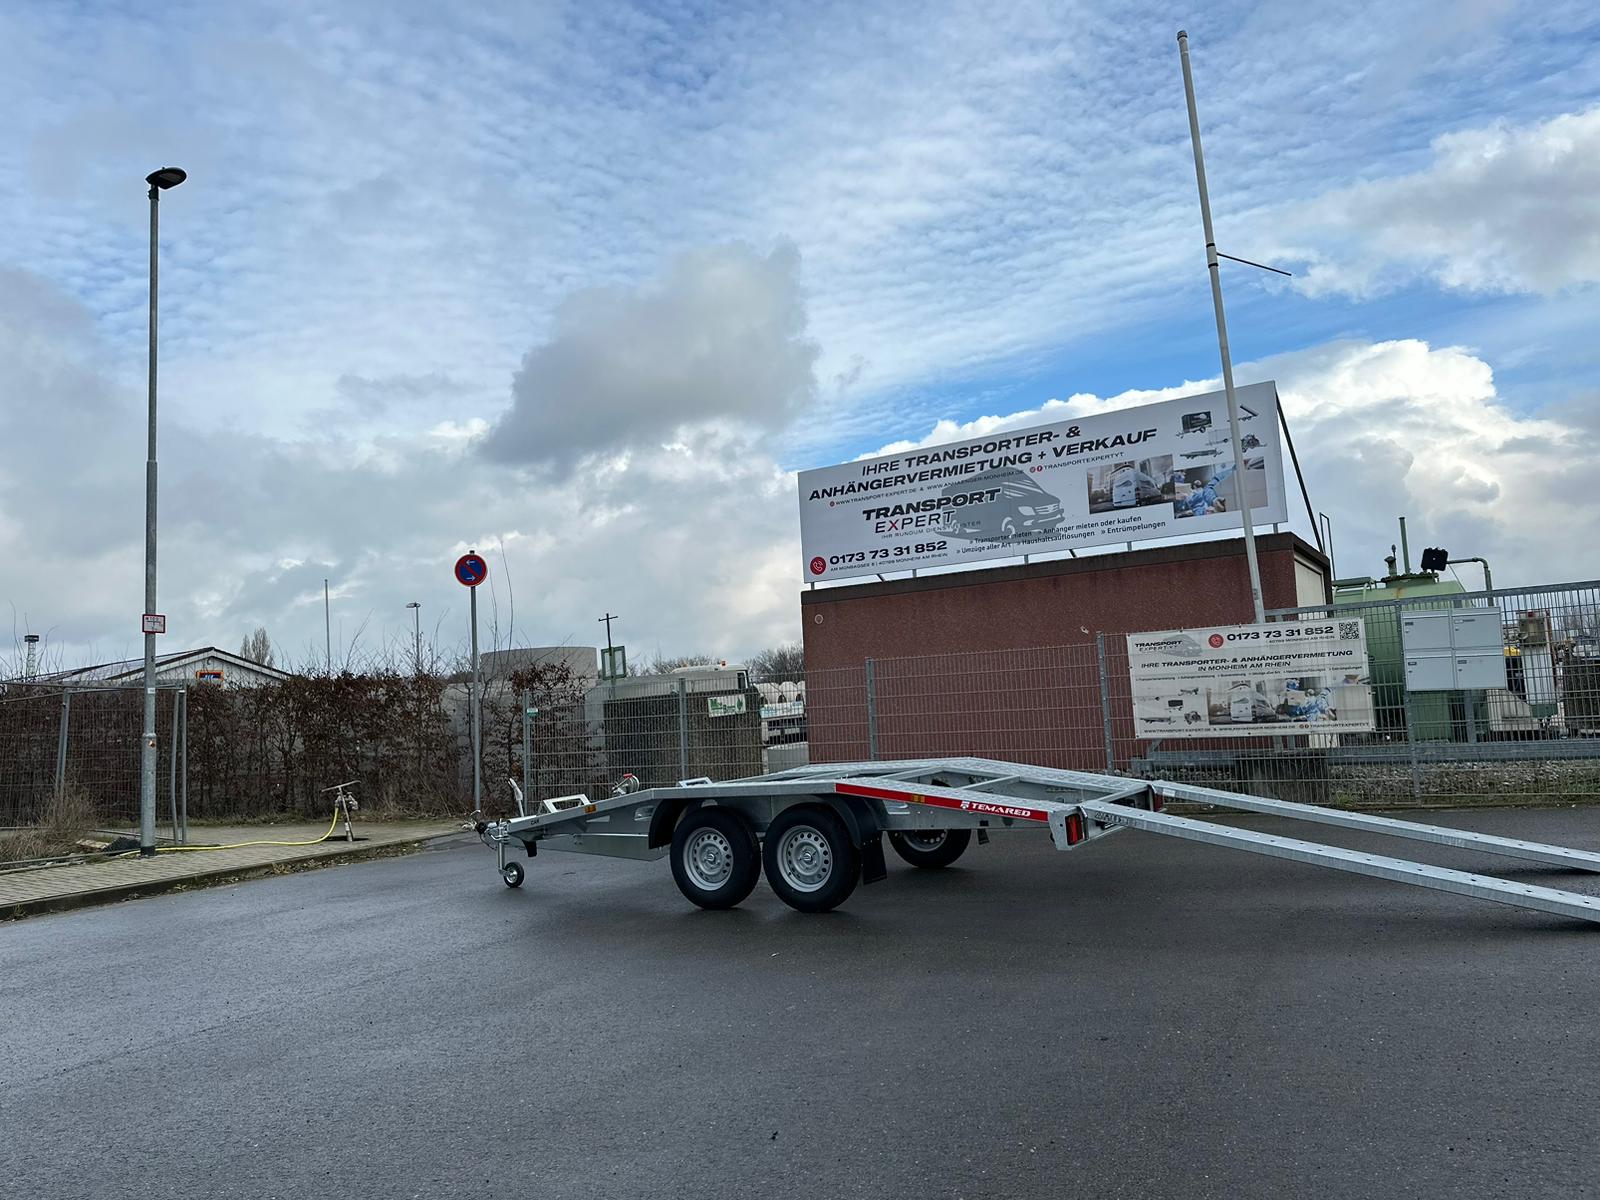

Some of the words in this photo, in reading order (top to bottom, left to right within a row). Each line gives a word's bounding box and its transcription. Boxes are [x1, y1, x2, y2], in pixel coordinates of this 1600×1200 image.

[862, 459, 900, 476] IHRE
[904, 430, 1060, 468] TRANSPORTER-
[1065, 425, 1081, 439] &
[1044, 452, 1125, 470] TRANSPORTEXPERTYT
[808, 452, 1033, 501] ANHÄNGERVERMIETUNG
[1038, 450, 1046, 460] +
[1052, 428, 1158, 458] VERKAUF
[862, 487, 1001, 521] TRANSPORT
[874, 510, 956, 534] EXPERT
[974, 533, 1010, 544] Transporter
[1075, 521, 1099, 531] mieten
[1100, 518, 1116, 527] oder
[1117, 515, 1142, 525] kaufen
[961, 544, 987, 554] Umzüge
[987, 543, 1001, 551] aller
[1001, 541, 1013, 549] Art
[1107, 520, 1166, 535] Entrümpelungen
[829, 552, 866, 565] 0173
[869, 548, 889, 560] 73
[893, 546, 911, 556] 31
[914, 540, 948, 555] 852
[1135, 640, 1183, 648] TRANSPORT
[1226, 631, 1260, 641] 0173
[1263, 630, 1282, 639] 73
[1285, 628, 1301, 637] 31
[1304, 626, 1334, 635] 852
[1161, 657, 1229, 667] TRANSPORTER-
[1240, 650, 1353, 663] ANHÄNGERVERMIETUNG
[971, 802, 1031, 818] TEMARED
